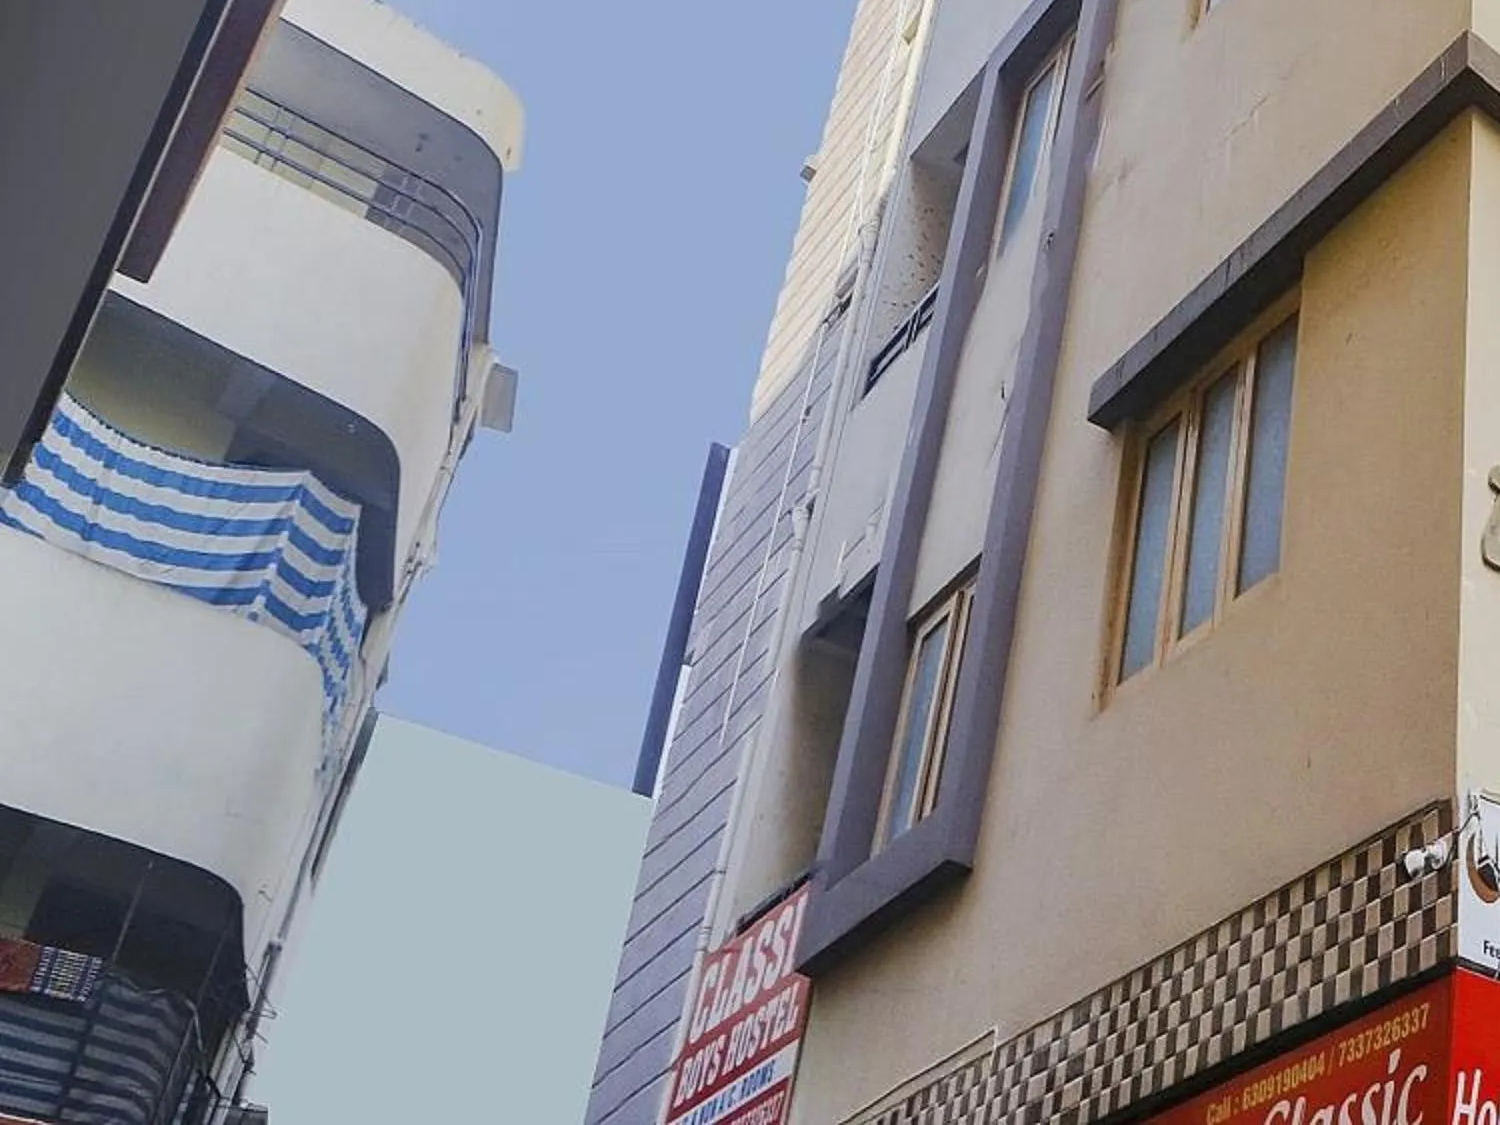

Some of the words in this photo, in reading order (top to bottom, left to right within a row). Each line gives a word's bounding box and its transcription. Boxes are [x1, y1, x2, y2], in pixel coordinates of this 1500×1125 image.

[689, 891, 809, 1044] CLASSI
[673, 1035, 727, 1108] BOYS
[722, 983, 800, 1076] HOSTEL
[1264, 1048, 1428, 1125] ssic
